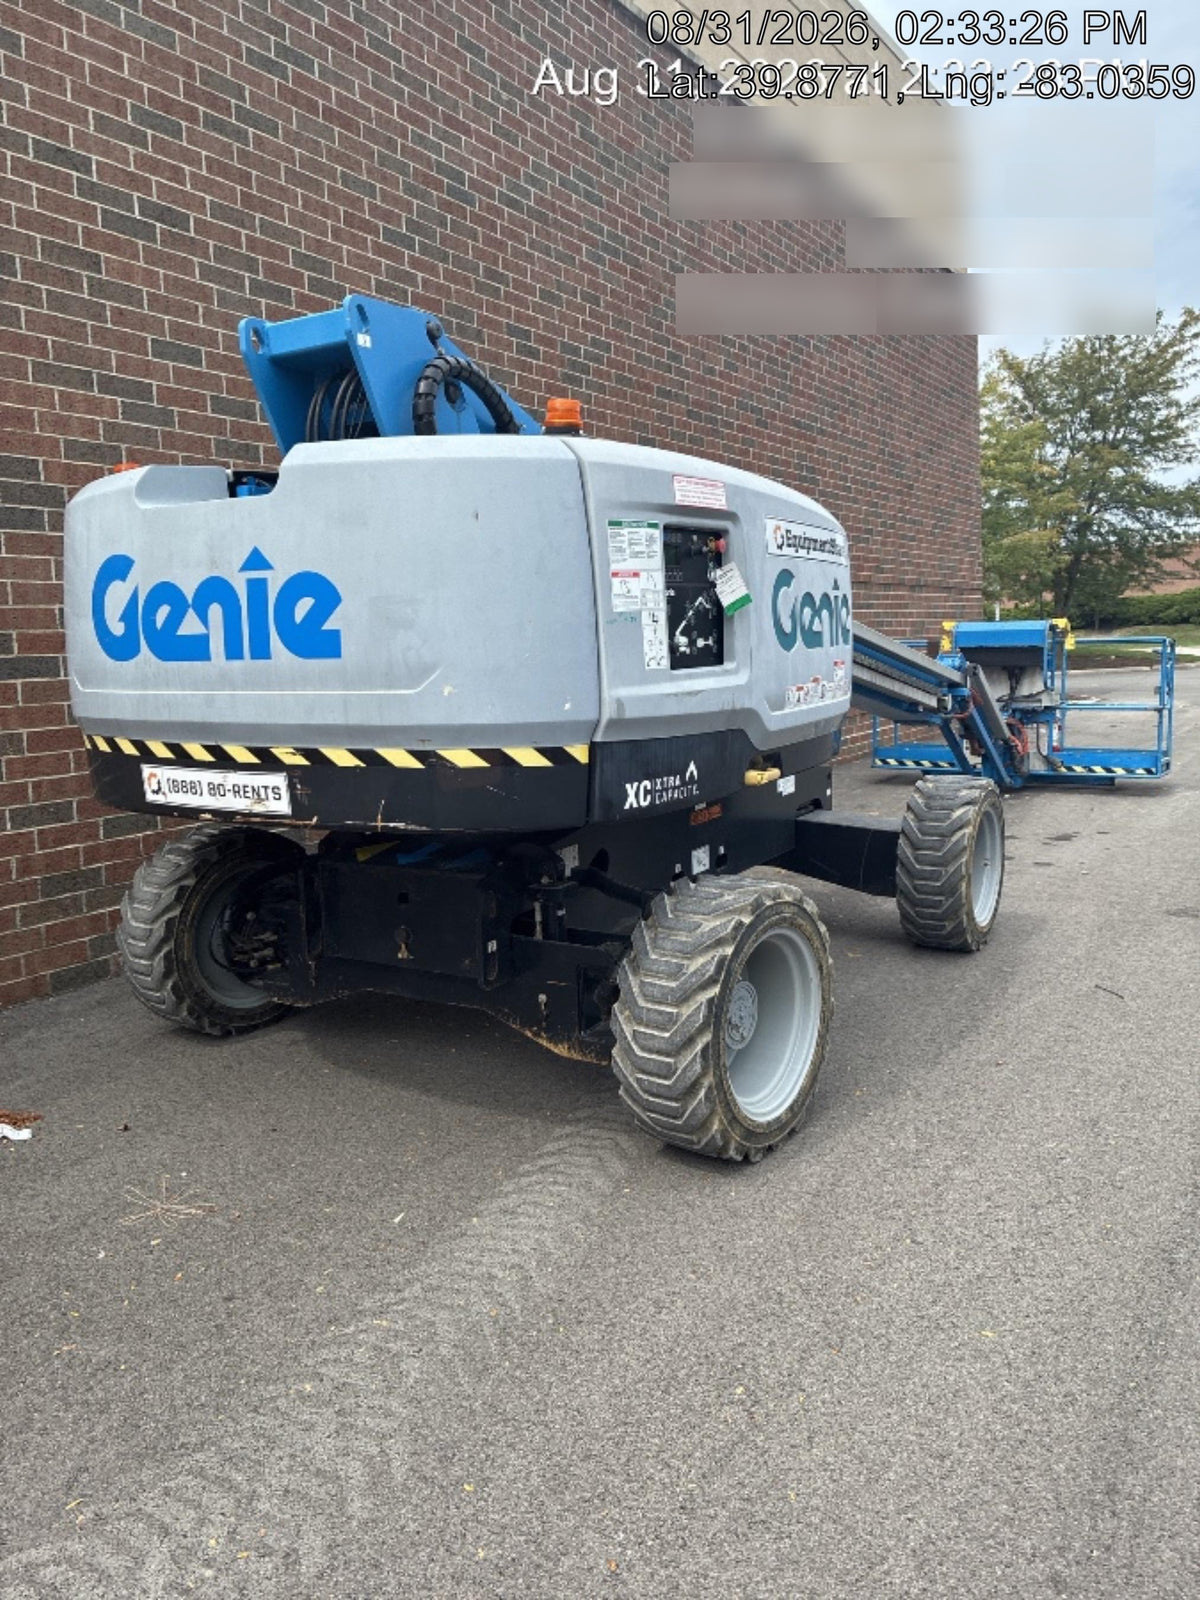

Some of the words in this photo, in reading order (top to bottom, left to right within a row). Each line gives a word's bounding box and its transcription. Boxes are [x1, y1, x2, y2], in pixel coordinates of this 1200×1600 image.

[92, 545, 343, 662] Genie
[772, 568, 851, 653] Genie
[166, 776, 204, 797] (888)
[624, 779, 652, 810] XC
[655, 774, 682, 791] XTRA
